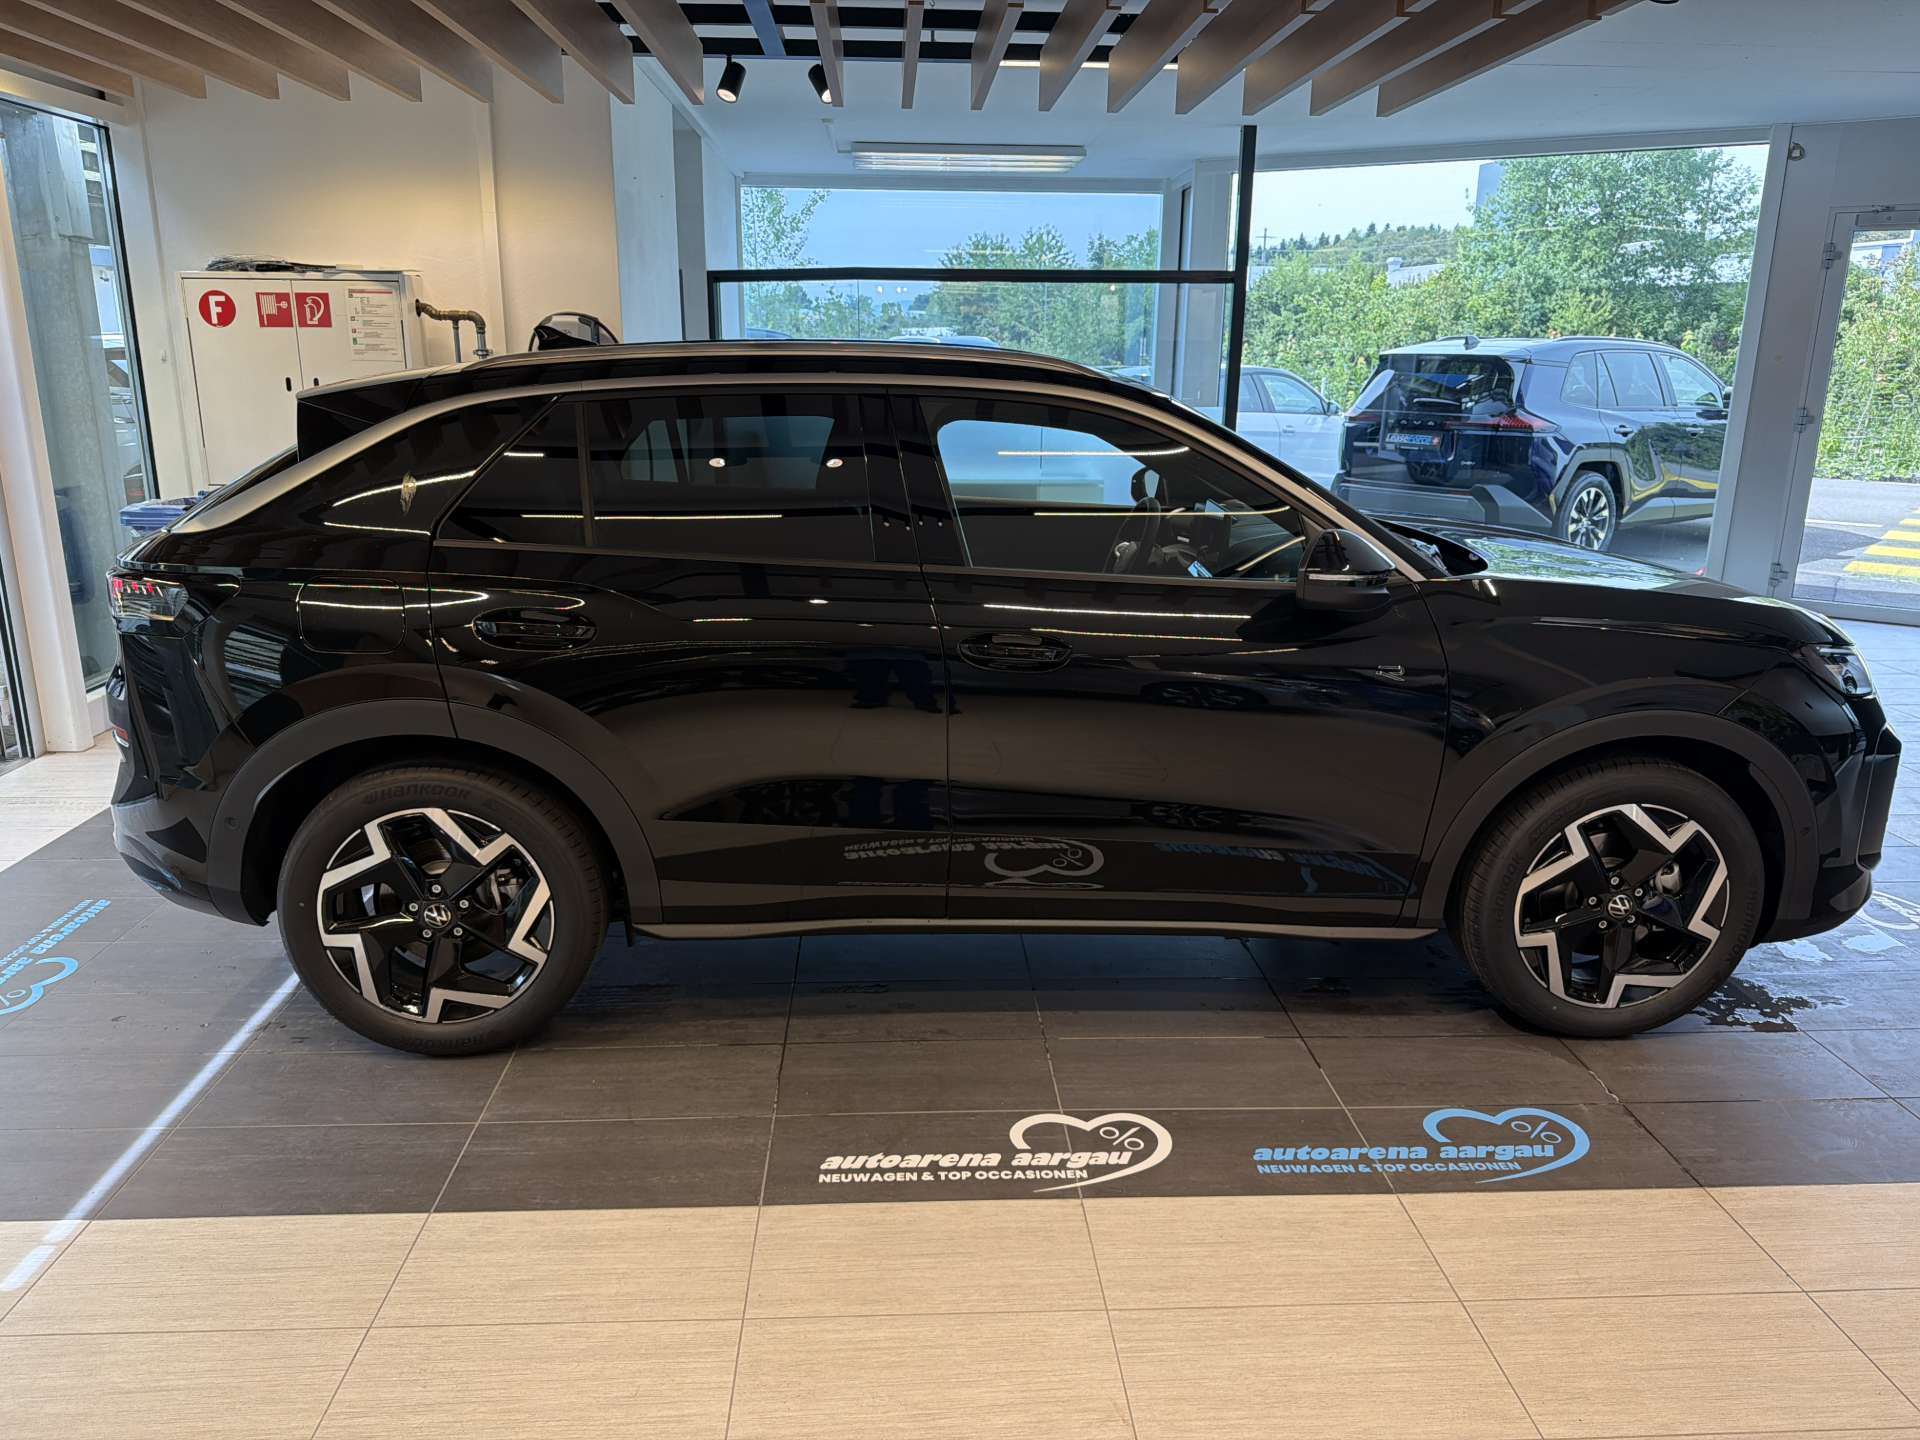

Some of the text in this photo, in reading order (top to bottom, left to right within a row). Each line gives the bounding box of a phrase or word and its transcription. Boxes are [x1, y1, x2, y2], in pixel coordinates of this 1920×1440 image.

[208, 295, 226, 325] F
[819, 1150, 1133, 1170] autoarena aargau
[1253, 1144, 1555, 1161] autoarena aargau
[818, 1169, 1089, 1184] NEUWAGEN & TOP OCCASIONEN
[1256, 1161, 1522, 1175] NEUWAGEN & TOP OCCASIONEN
